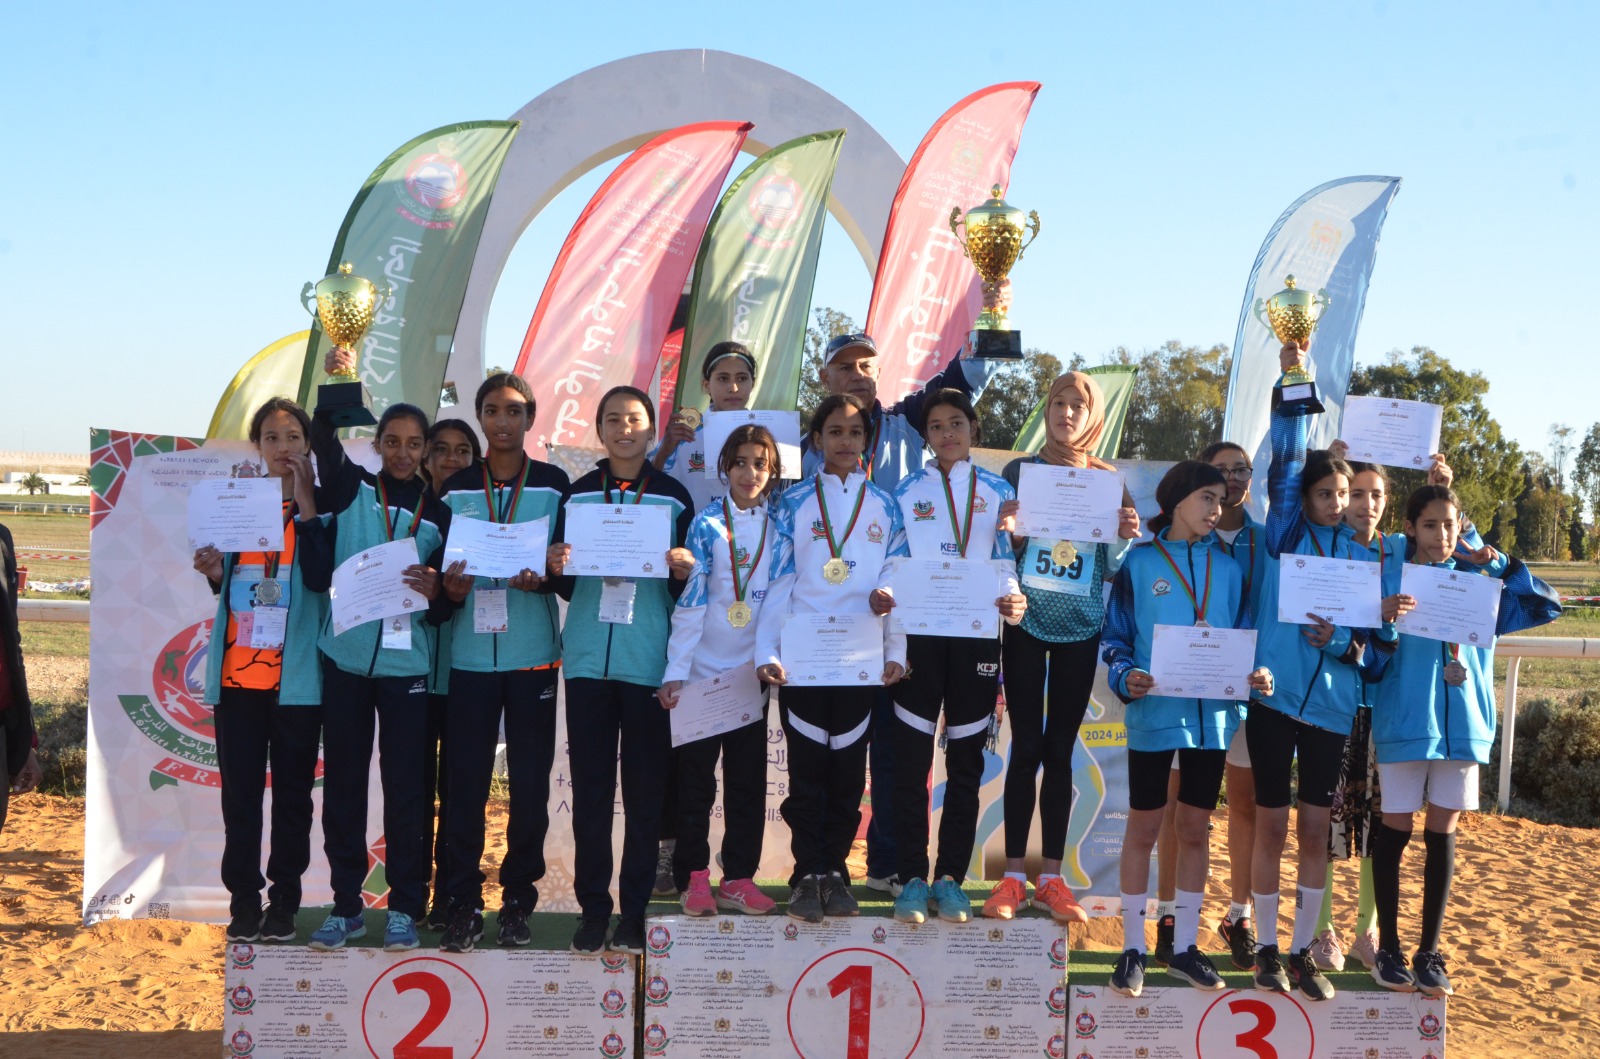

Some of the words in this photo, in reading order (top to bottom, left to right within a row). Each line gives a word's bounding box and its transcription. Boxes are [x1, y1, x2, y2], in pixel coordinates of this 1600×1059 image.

[1085, 730, 1113, 741] 2024
[392, 971, 453, 1058] 2
[827, 965, 873, 1058] 1
[1228, 999, 1279, 1058] 3
